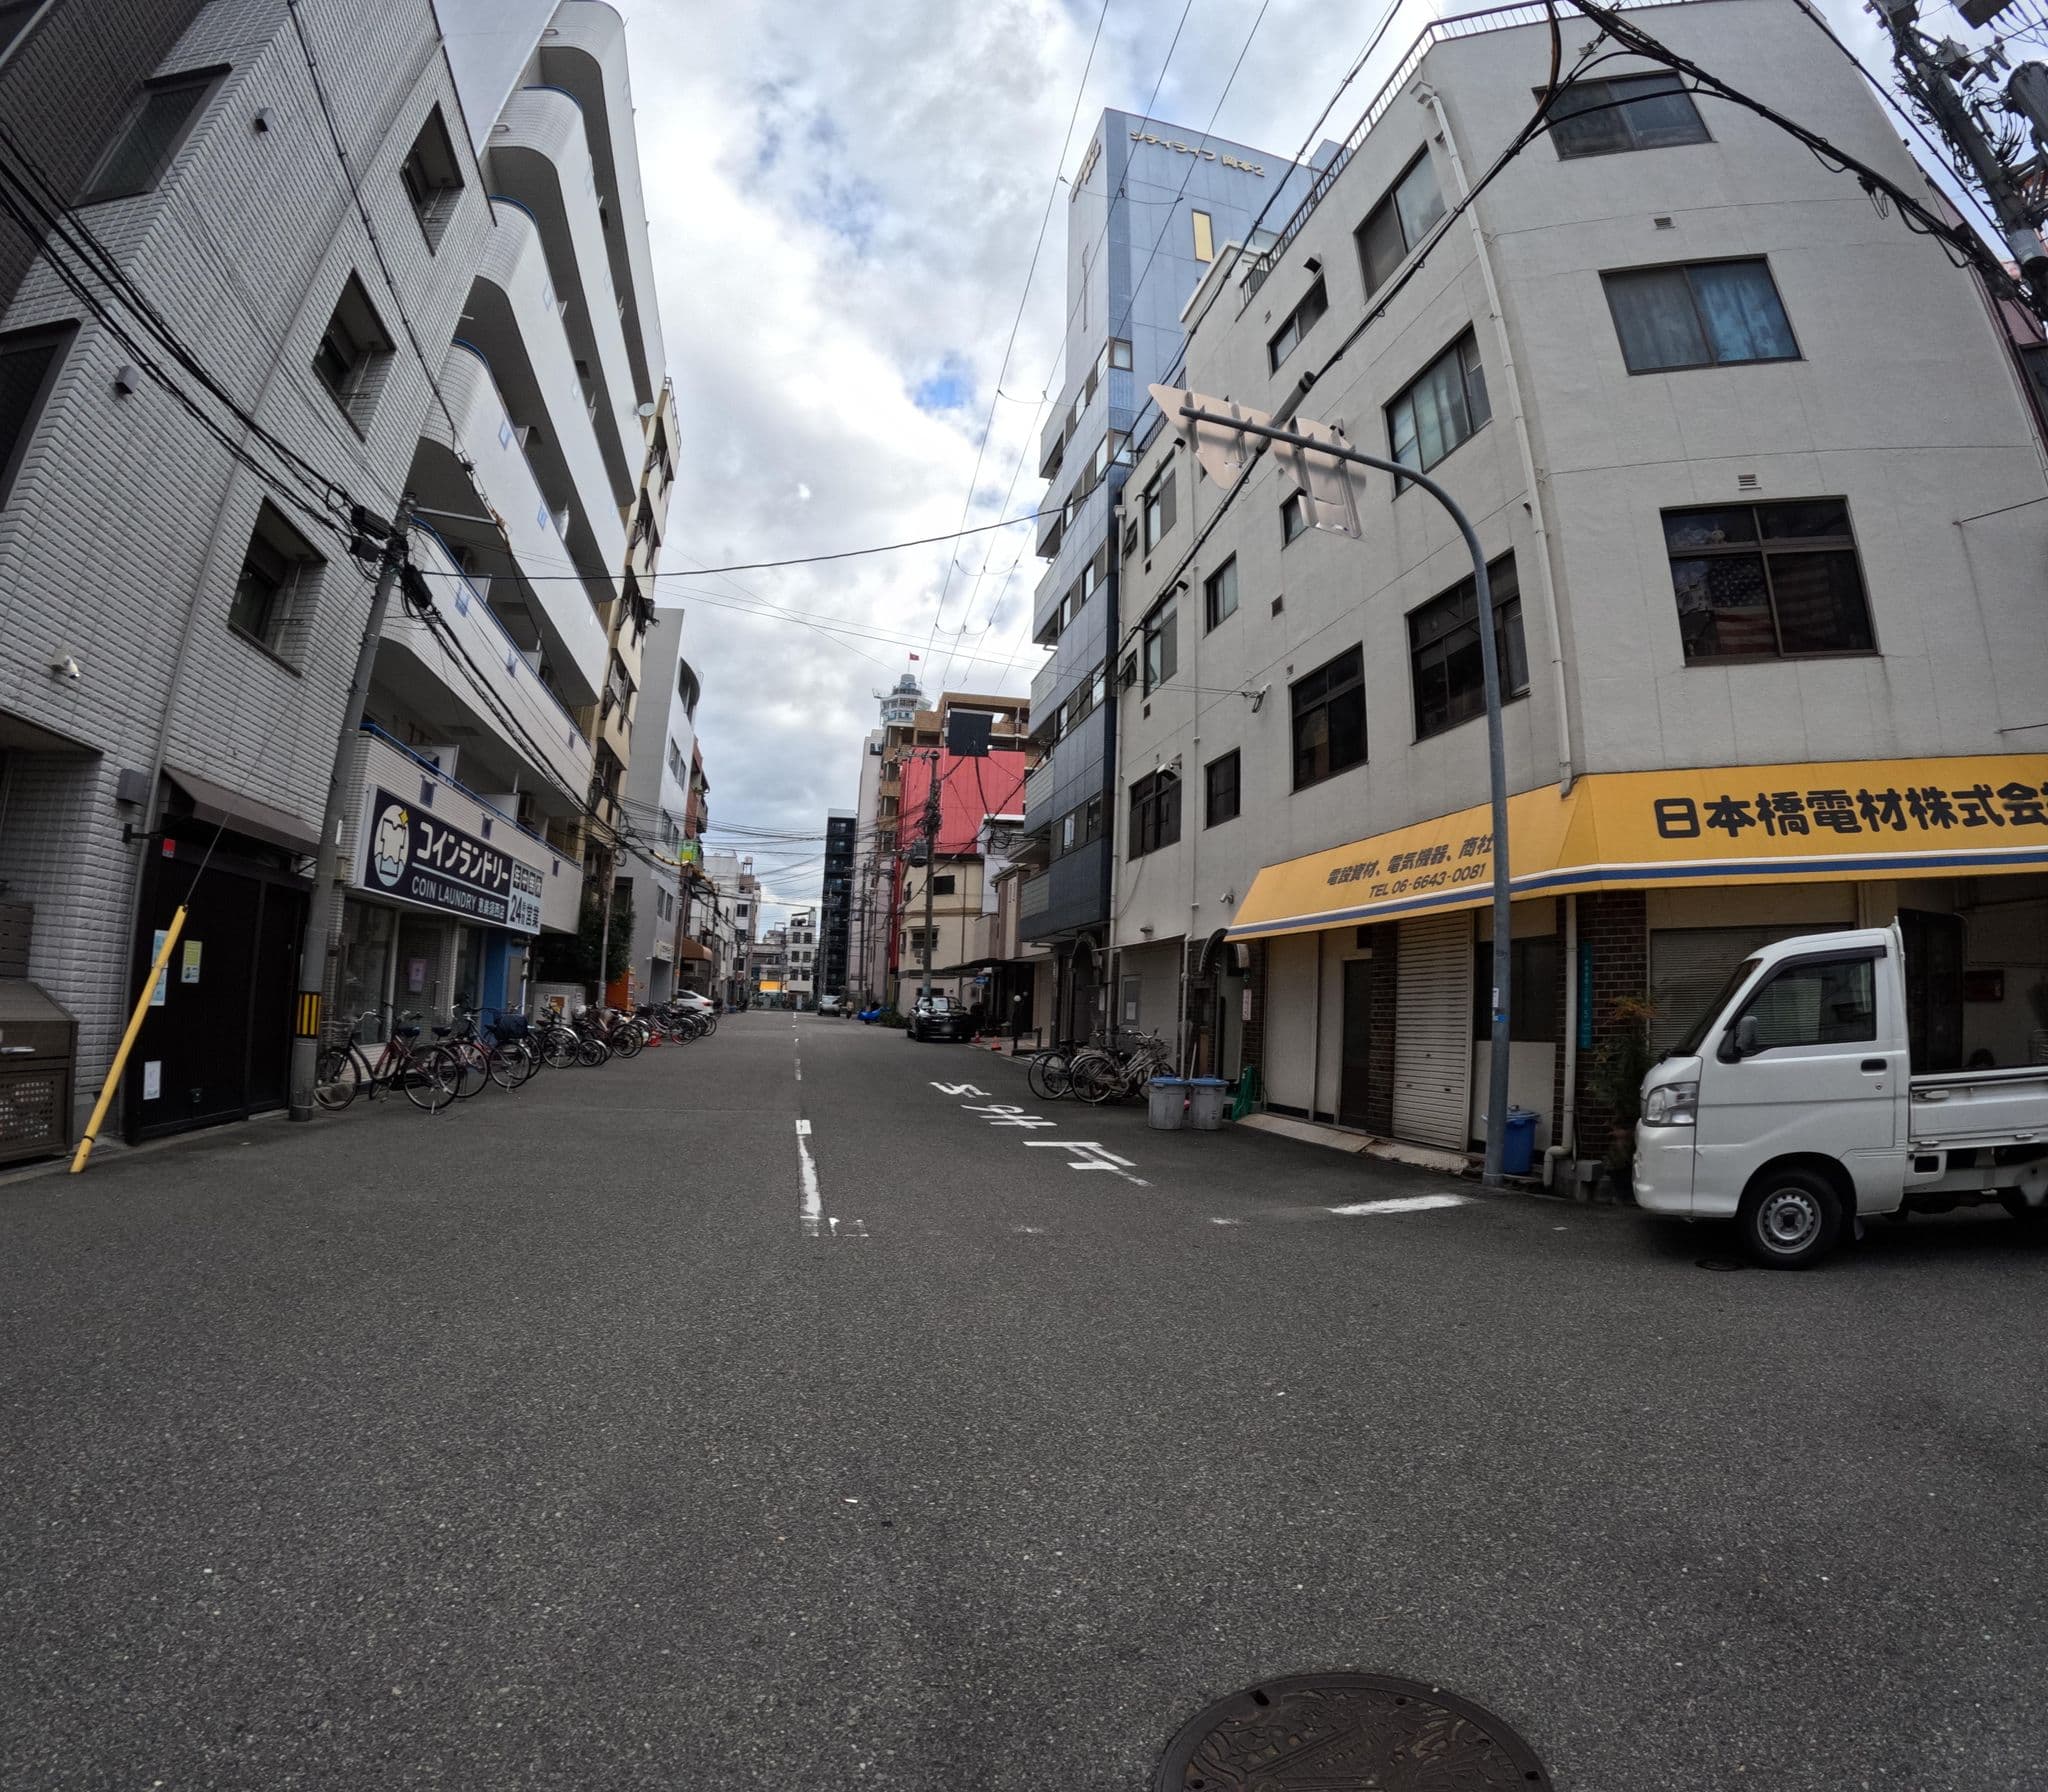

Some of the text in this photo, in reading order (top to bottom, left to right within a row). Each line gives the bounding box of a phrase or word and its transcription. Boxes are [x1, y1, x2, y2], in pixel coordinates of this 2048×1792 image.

[1130, 130, 1216, 161] シティライフ
[1653, 782, 2048, 838] 日本橋電材株式会
[416, 822, 509, 888] コインランドリー
[411, 876, 437, 900] COIN
[438, 886, 477, 912] LAUNDRY
[1369, 863, 1487, 898] TEL 06-6643-0081
